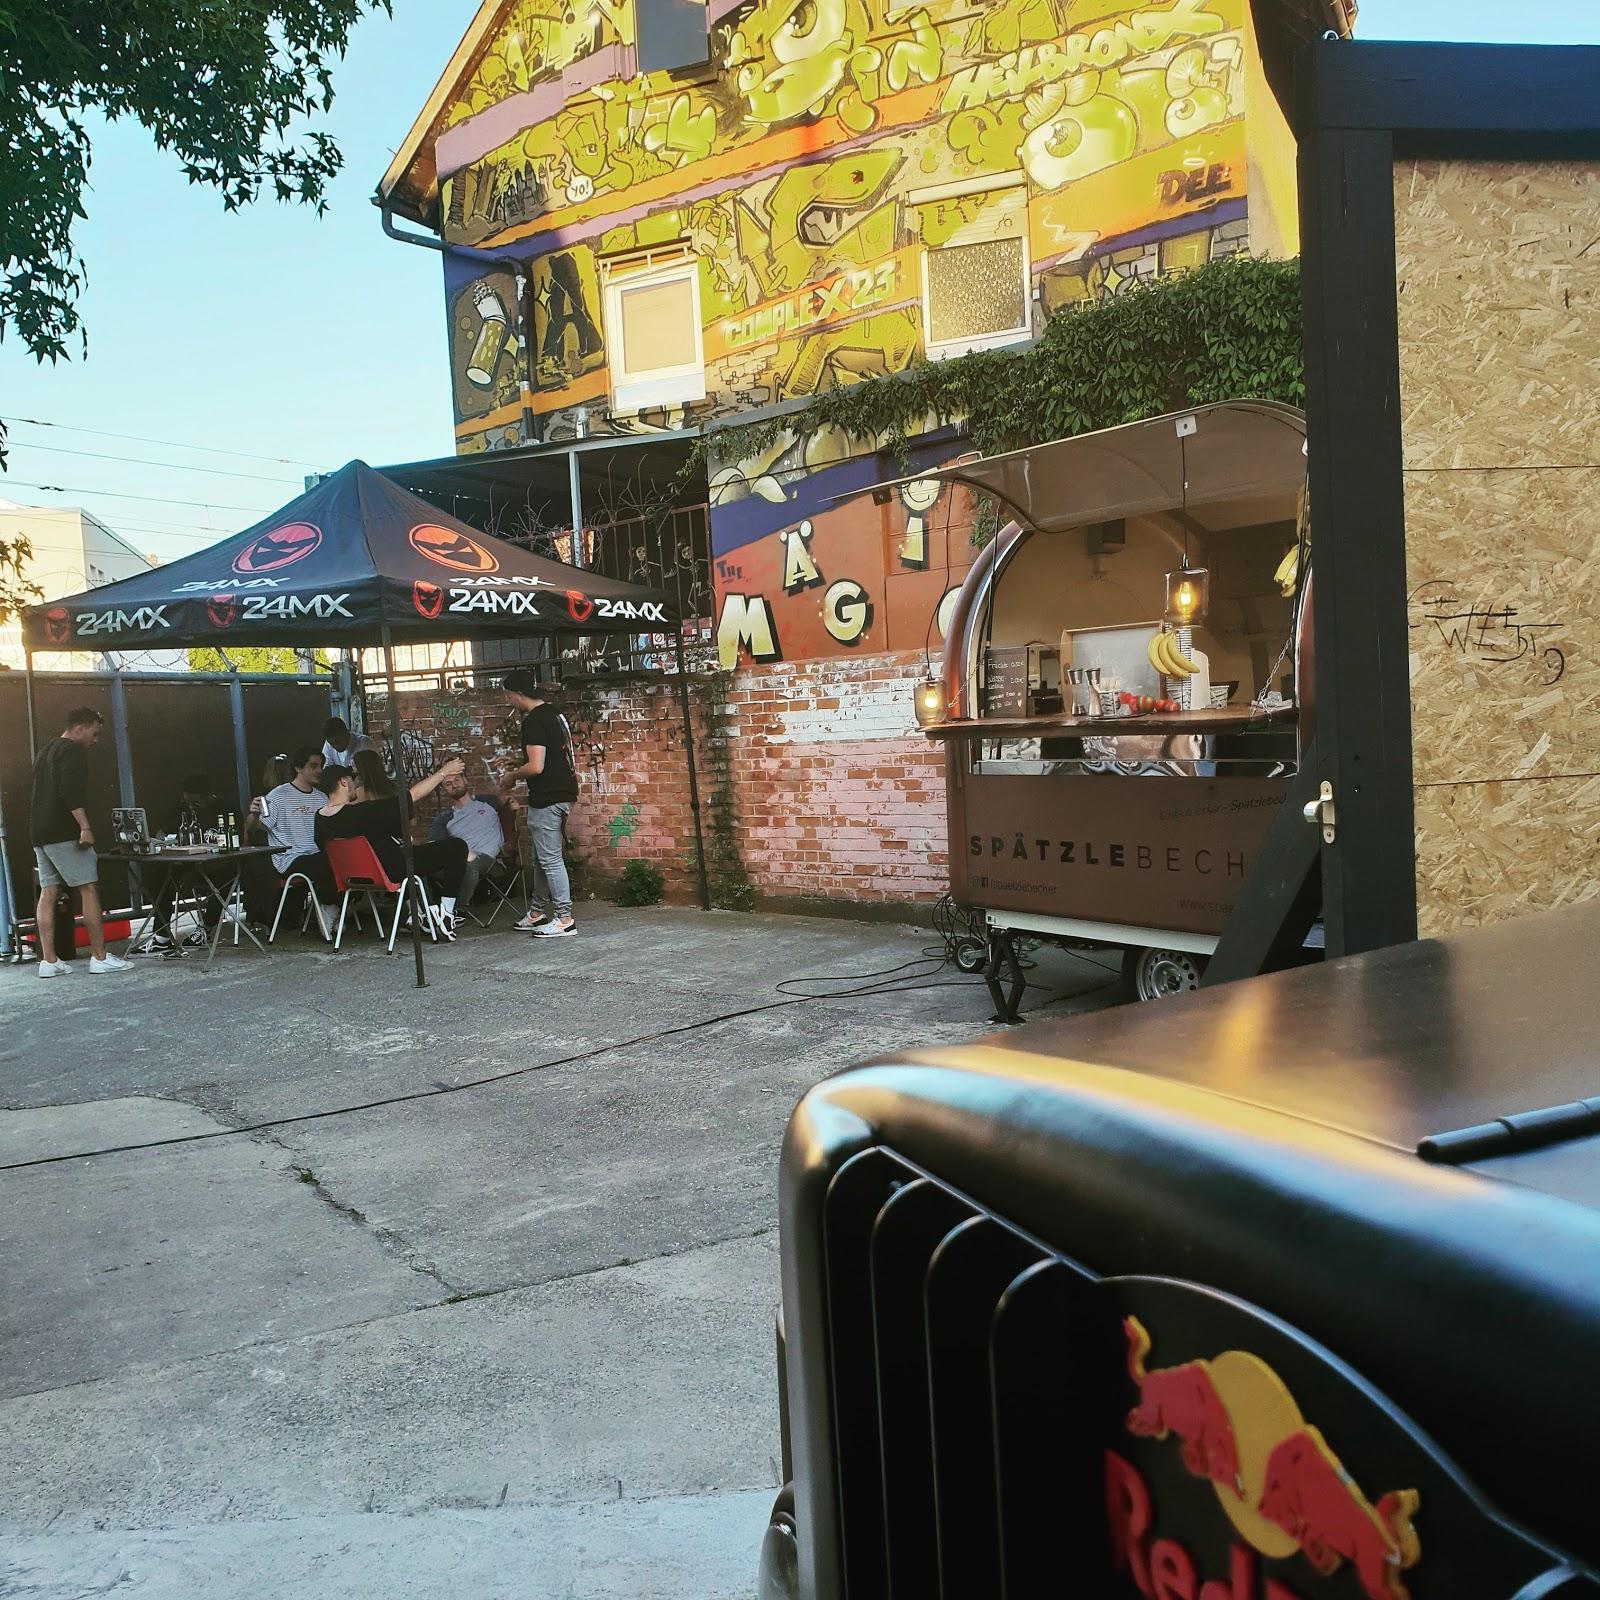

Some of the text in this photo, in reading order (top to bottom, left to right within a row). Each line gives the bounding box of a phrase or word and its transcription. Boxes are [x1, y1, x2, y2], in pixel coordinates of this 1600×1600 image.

[570, 179, 590, 198] YO!
[1157, 161, 1232, 207] DEE
[724, 256, 897, 349] COMPLEX 23
[171, 577, 291, 593] 24MX
[449, 576, 555, 587] 24MX
[242, 593, 354, 620] 24MX
[449, 588, 540, 615] 24MX
[594, 598, 669, 623] 24MX
[75, 604, 172, 636] 24MX
